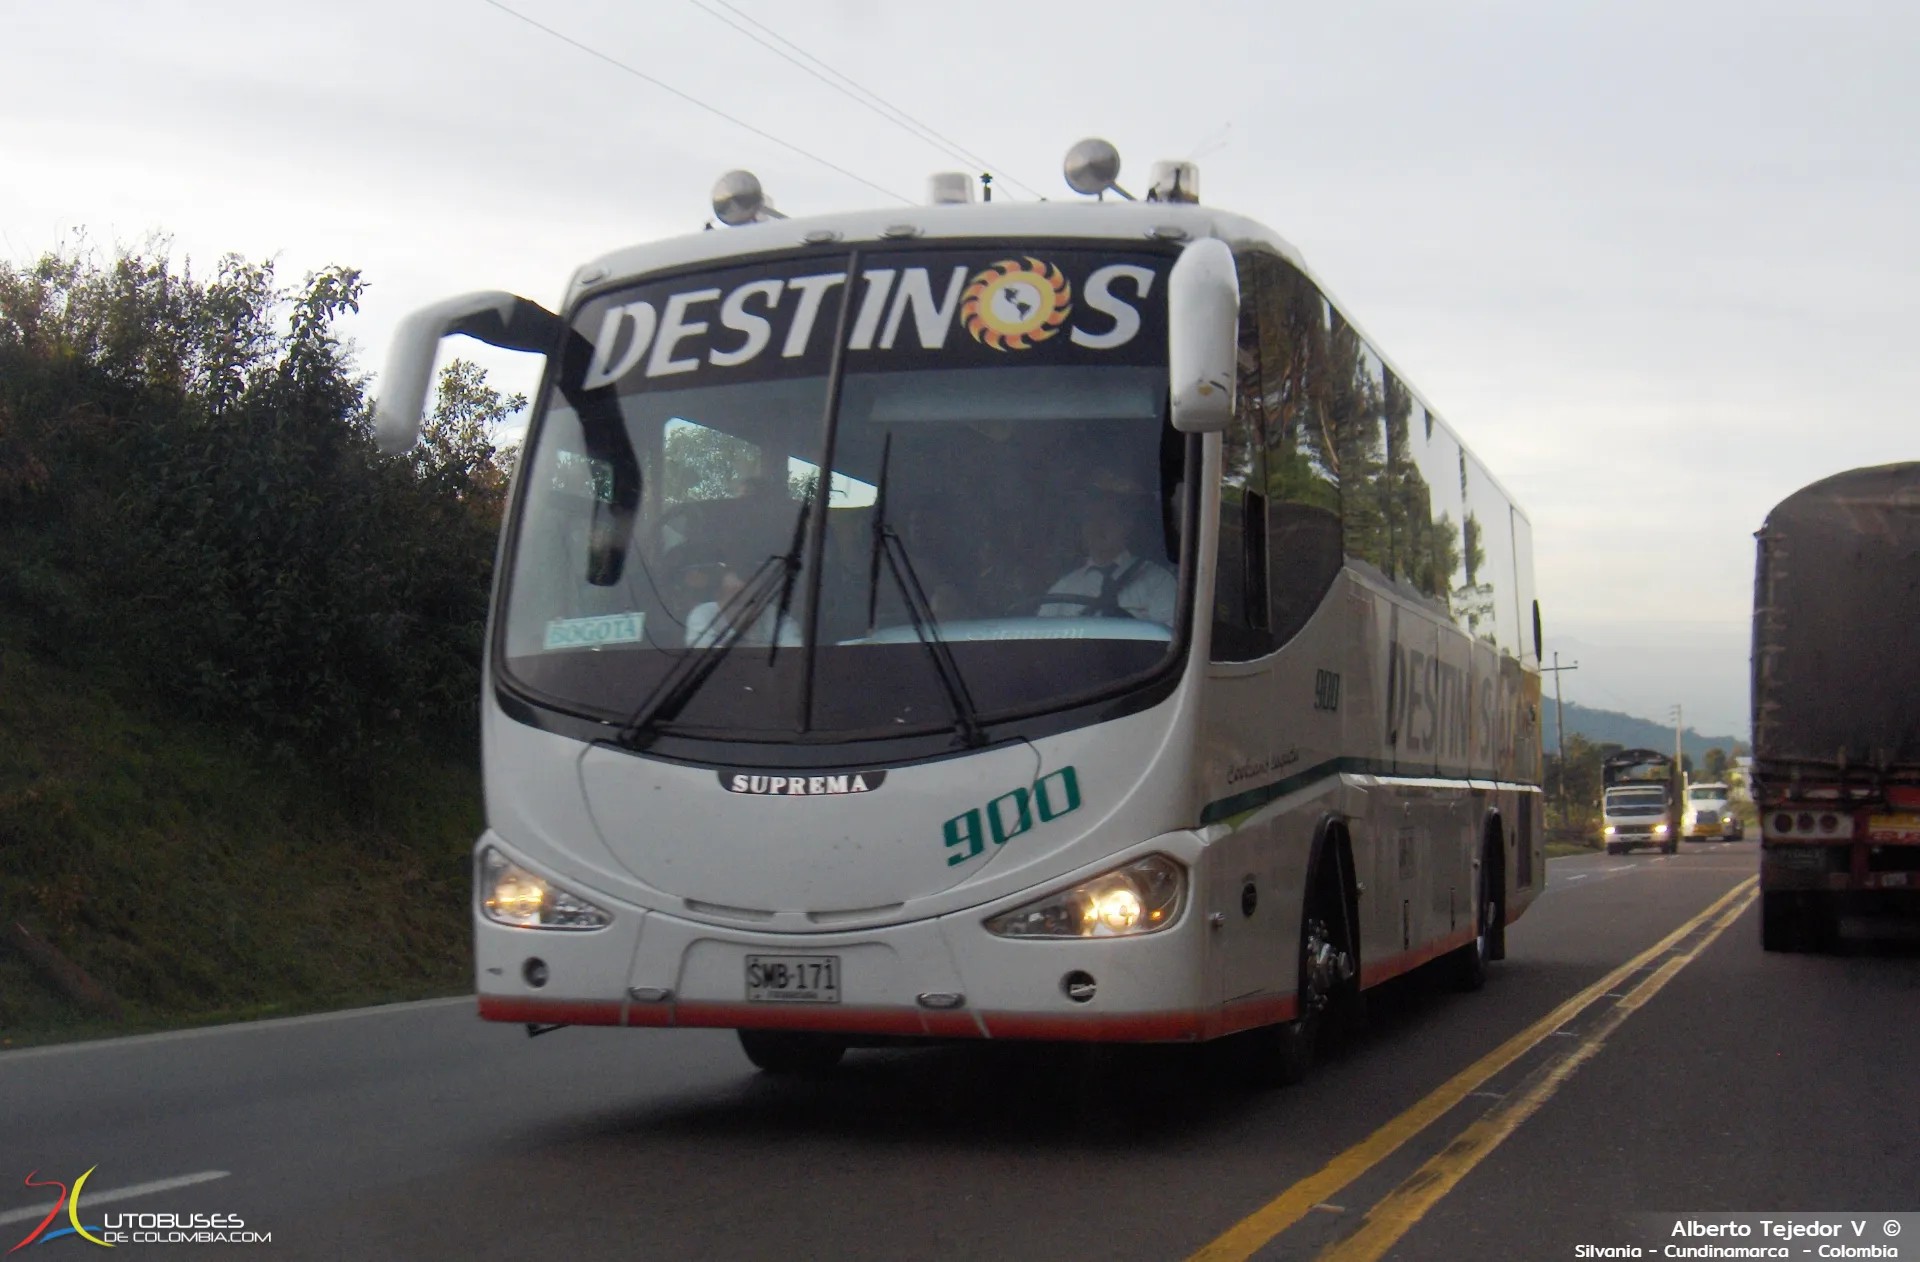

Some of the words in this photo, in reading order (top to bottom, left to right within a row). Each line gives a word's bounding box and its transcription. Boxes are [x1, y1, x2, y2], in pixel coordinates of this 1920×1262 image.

[582, 256, 1156, 390] DESTINOS
[1314, 668, 1340, 712] 900
[1385, 640, 1494, 762] DESTINS
[732, 774, 869, 795] SUPREMA
[943, 765, 1081, 867] 900
[748, 963, 836, 990] SWB-171
